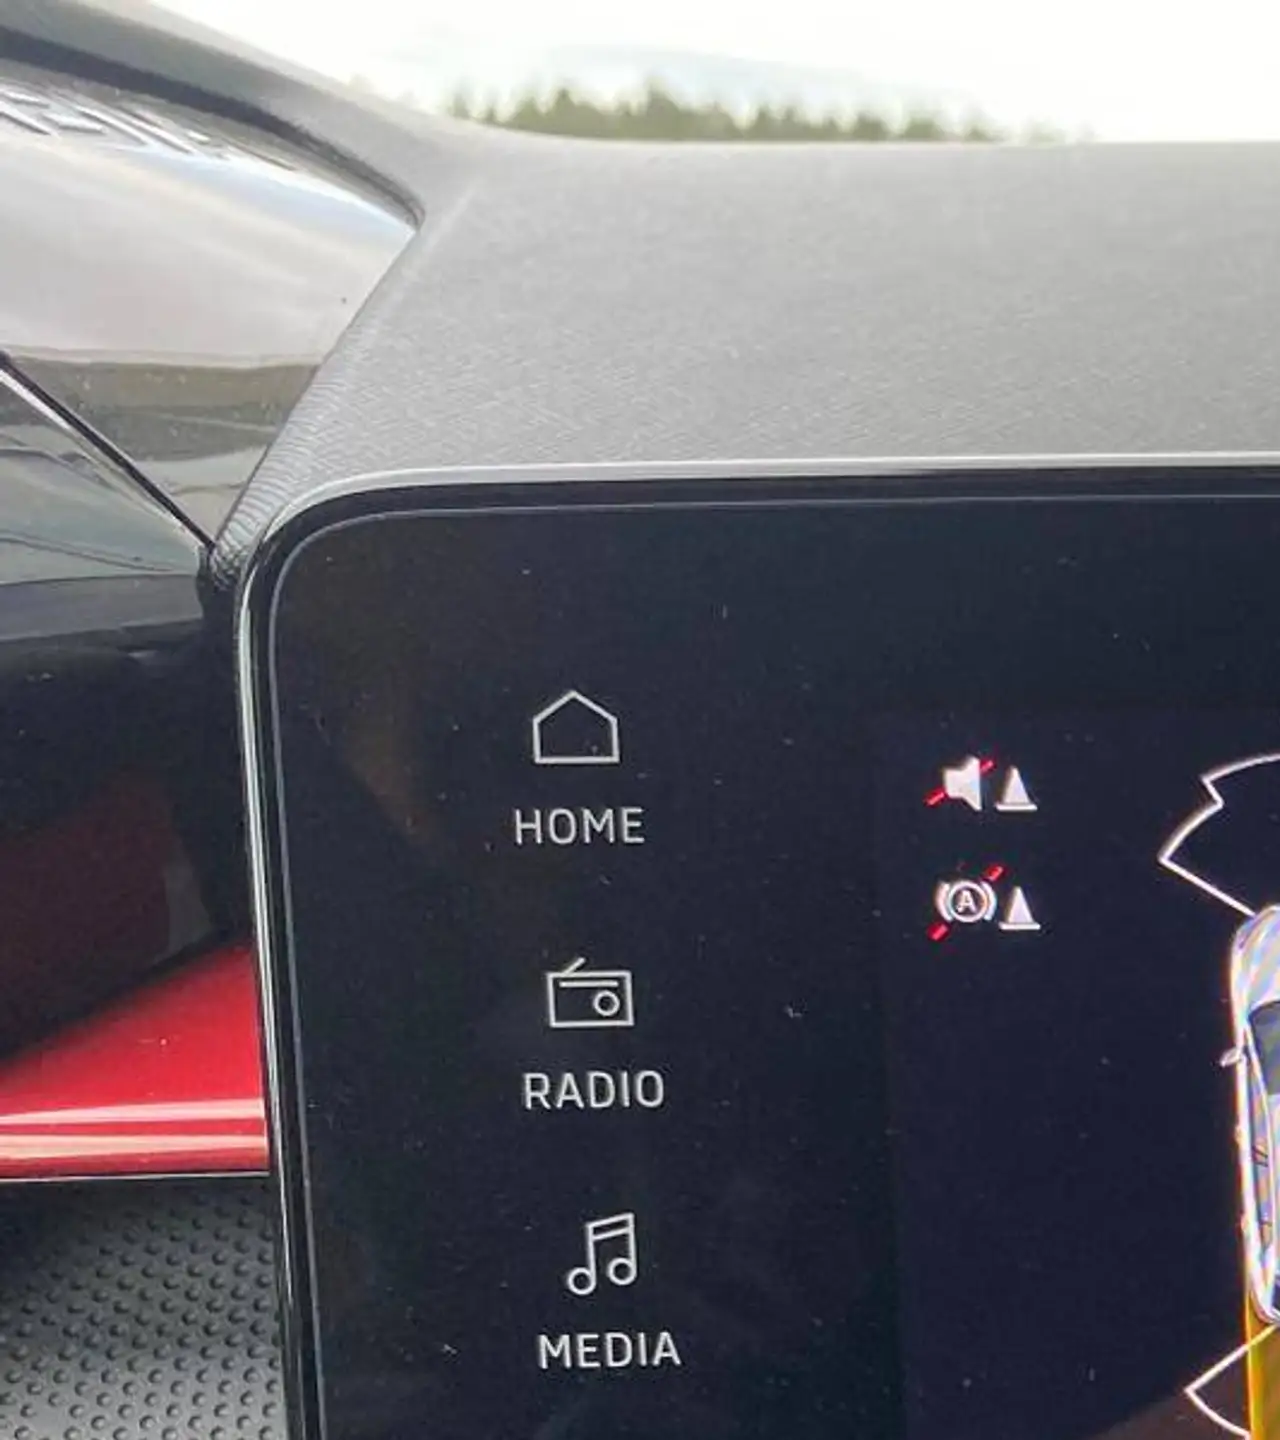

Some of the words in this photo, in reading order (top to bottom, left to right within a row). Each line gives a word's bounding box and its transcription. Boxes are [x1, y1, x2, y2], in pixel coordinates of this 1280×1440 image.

[512, 805, 647, 847] HOME
[521, 1068, 666, 1112] RADIO
[535, 1330, 683, 1372] MEDIA
